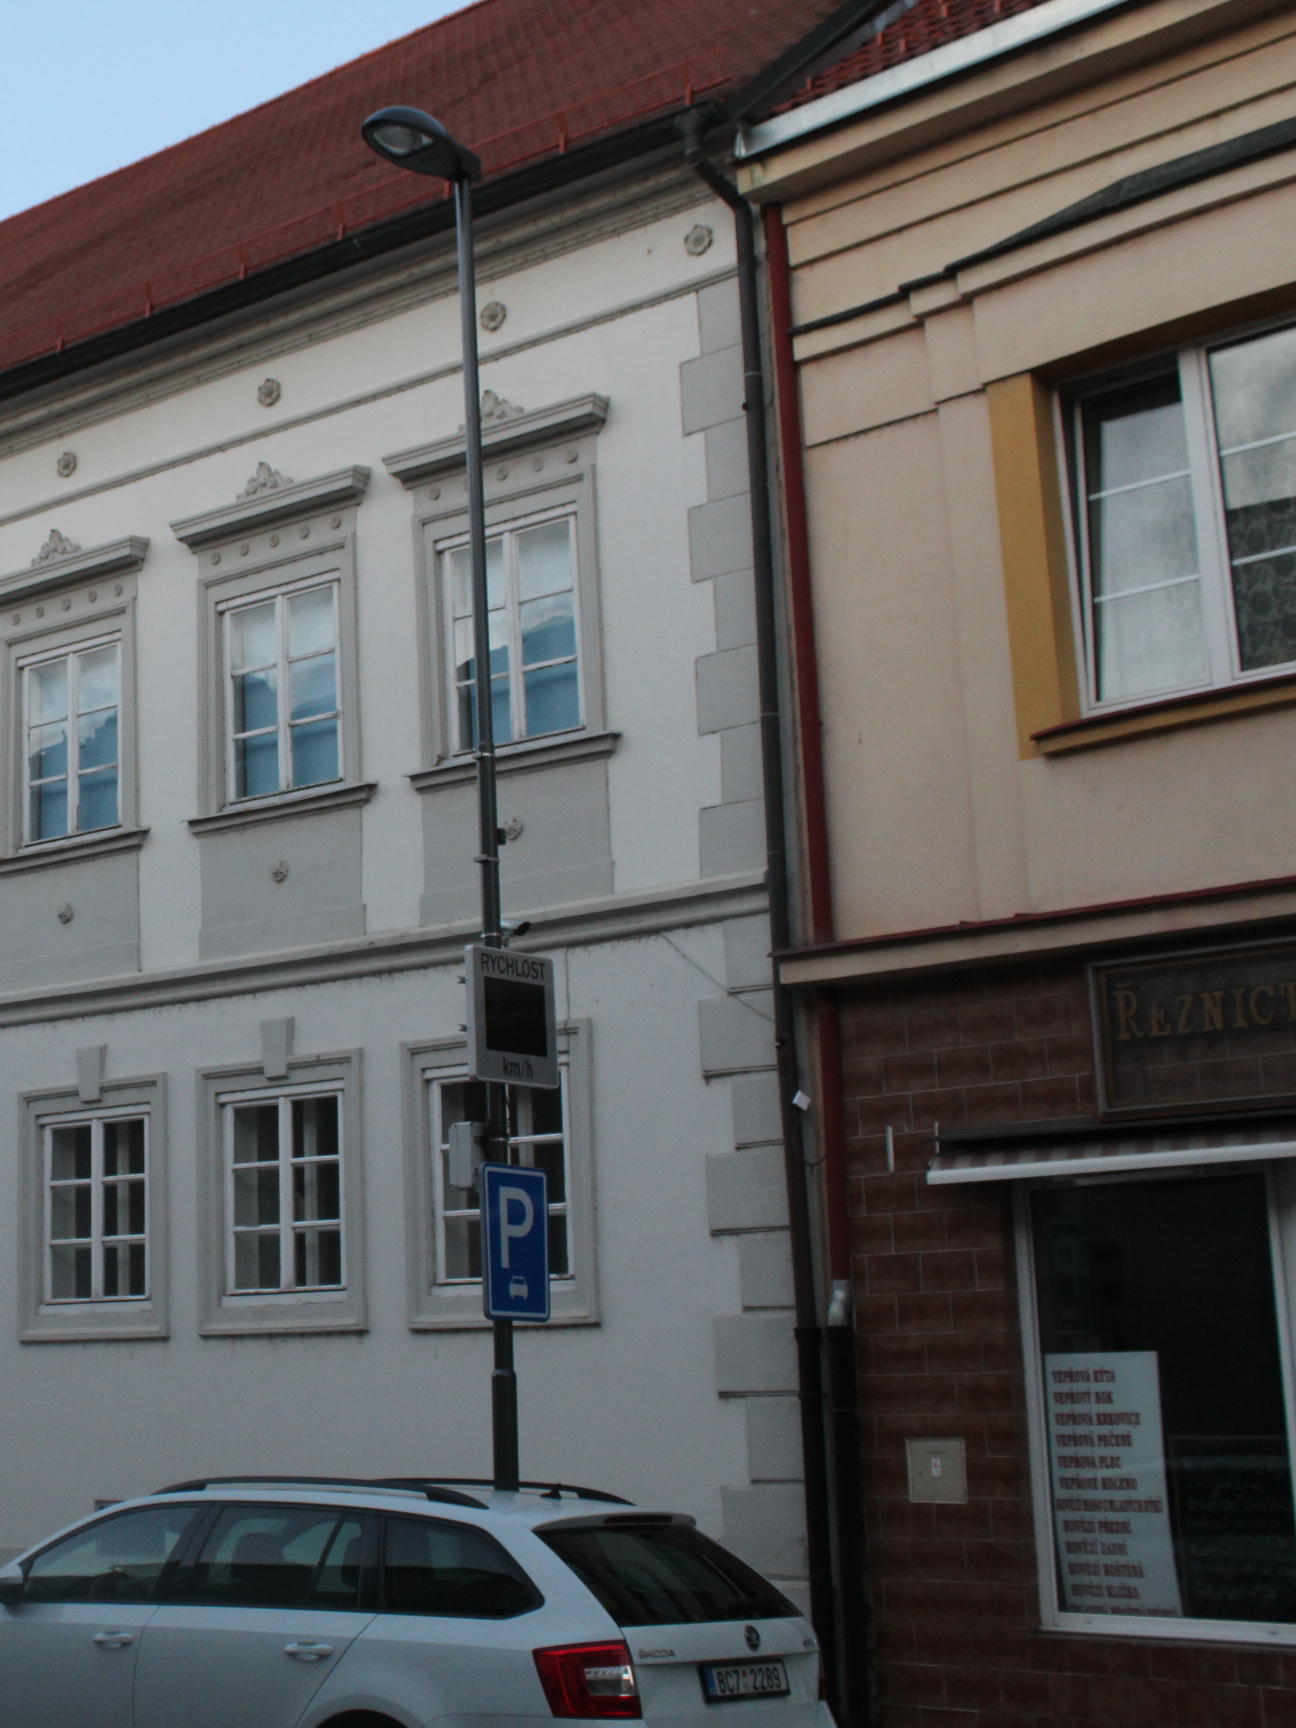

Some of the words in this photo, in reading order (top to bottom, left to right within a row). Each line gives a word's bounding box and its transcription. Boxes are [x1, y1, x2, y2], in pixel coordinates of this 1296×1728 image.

[481, 953, 545, 981] RYCHLOST
[503, 1056, 534, 1079] km/h
[499, 1186, 534, 1269] P
[716, 1670, 741, 1694] 8C7
[749, 1666, 782, 1692] 2289
